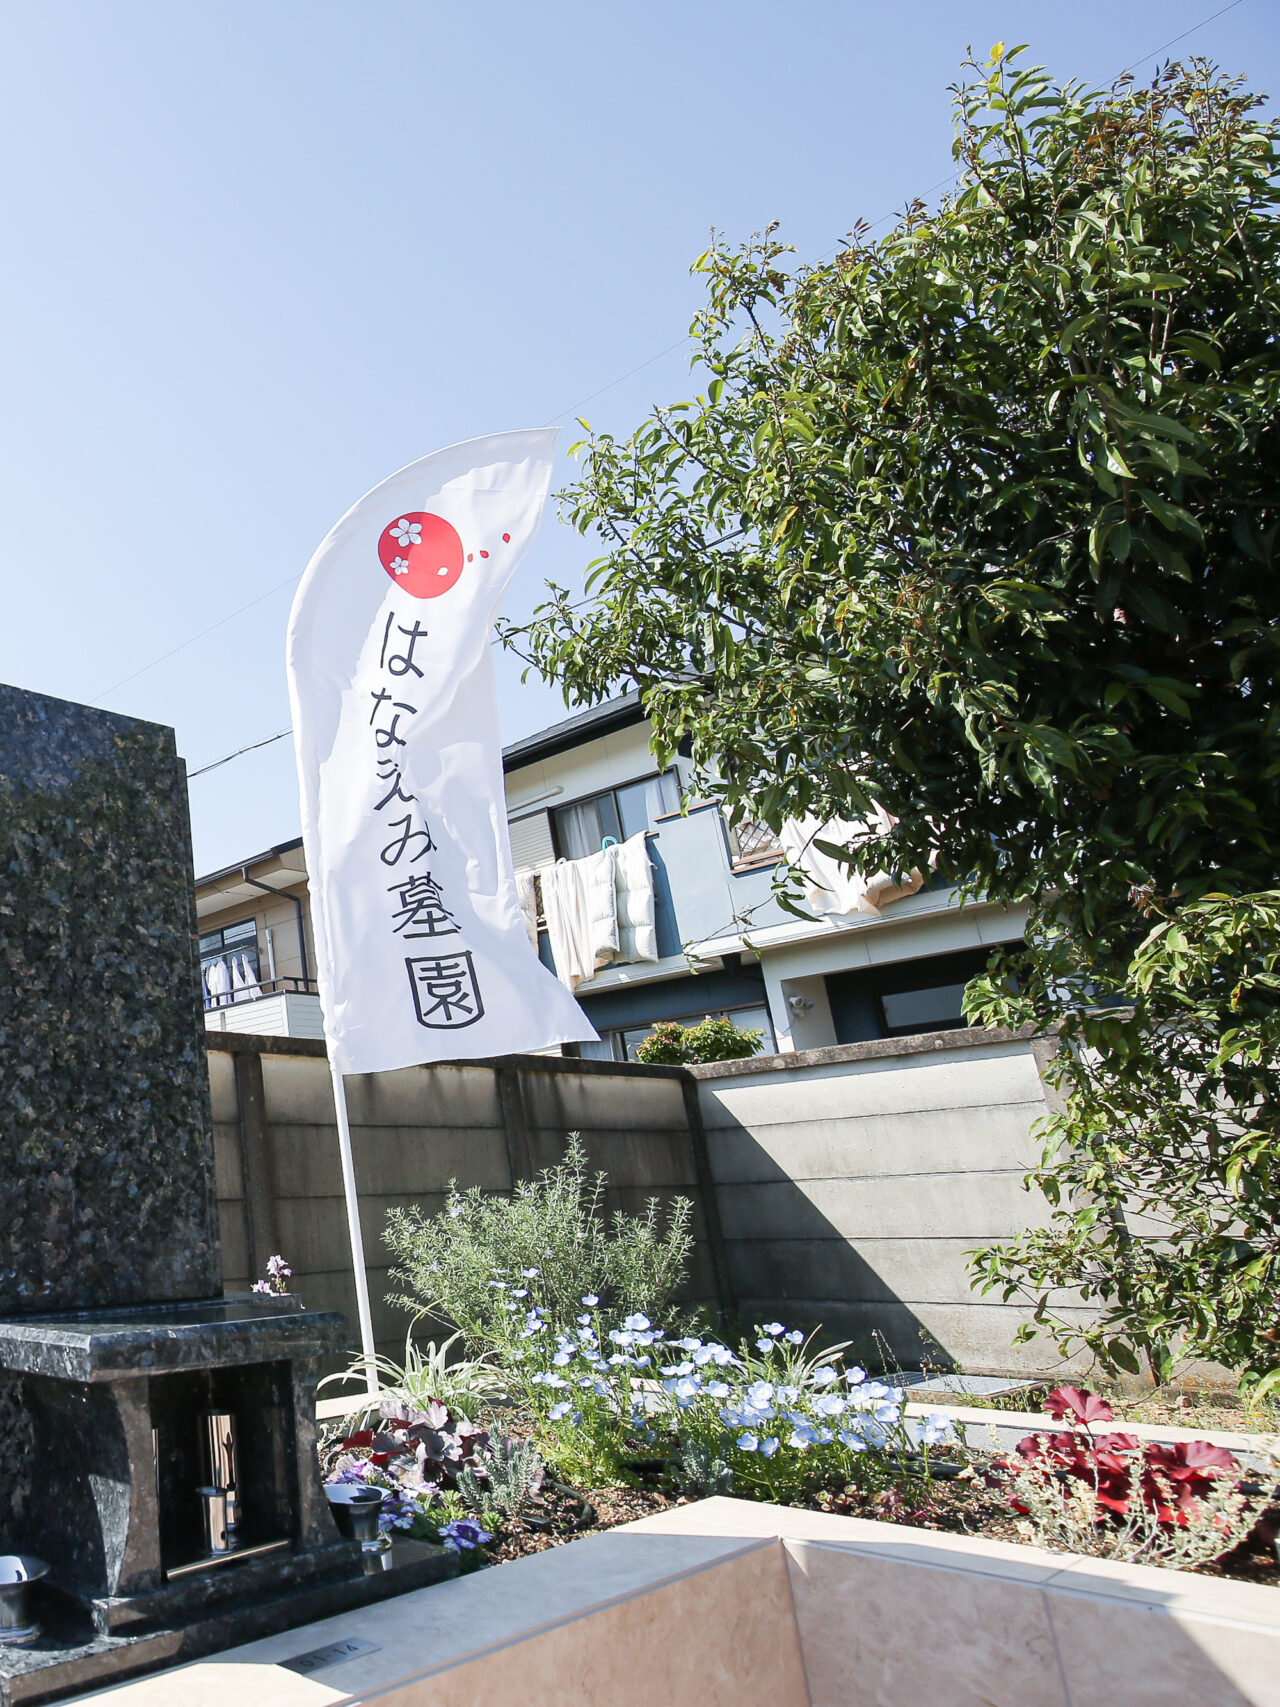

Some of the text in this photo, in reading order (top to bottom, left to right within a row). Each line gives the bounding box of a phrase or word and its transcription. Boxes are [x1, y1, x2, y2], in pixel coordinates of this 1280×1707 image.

[370, 611, 484, 1029] はなえみ墓園
[299, 1643, 360, 1668] 01-14
